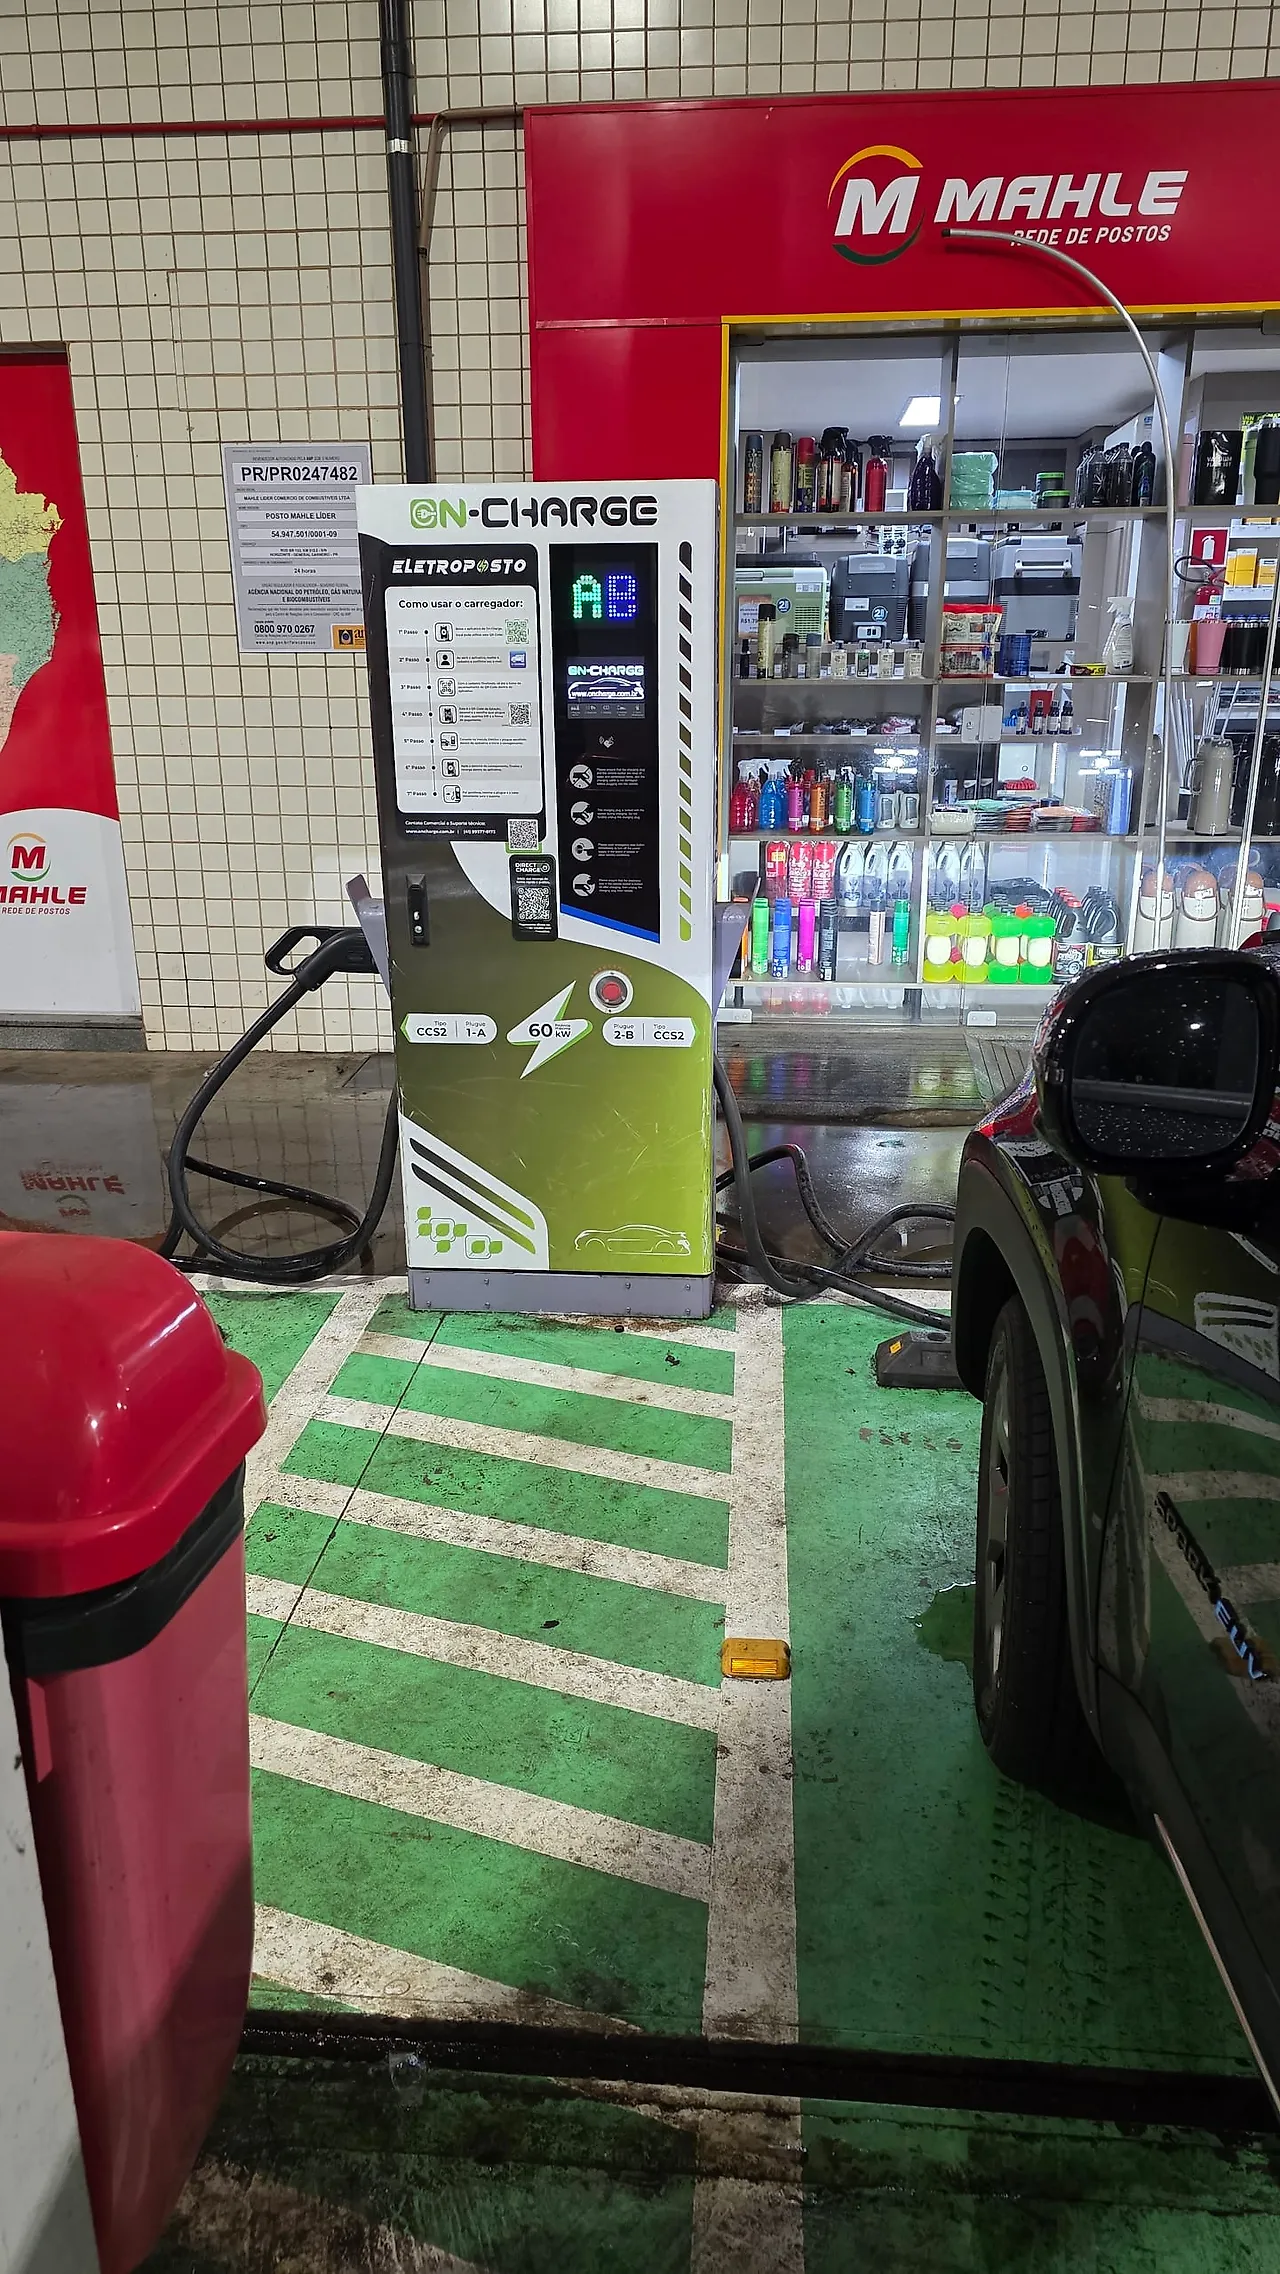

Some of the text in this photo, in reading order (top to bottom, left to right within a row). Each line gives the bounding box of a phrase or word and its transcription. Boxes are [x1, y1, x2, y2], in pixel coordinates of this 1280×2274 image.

[934, 169, 1189, 223] MAHLE
[834, 176, 920, 236] M
[1010, 225, 1172, 246] REDE DE POSTOS
[241, 466, 358, 482] PR/PR0247482
[410, 495, 658, 529] ON-CHARGE
[392, 558, 527, 575] ELETROPOSTO
[398, 599, 428, 610] Como
[464, 599, 524, 611] carregador:
[572, 574, 637, 619] A B
[254, 625, 315, 633] 0800 970 0267
[568, 665, 644, 676] ON-CHARGE
[12, 846, 46, 869] M
[0, 886, 87, 904] AHLE
[417, 1027, 486, 1038] CCS2 1-A
[529, 1023, 553, 1037] 60
[614, 1030, 684, 1040] 2-B CCS2
[1215, 1599, 1267, 1680] EUV
